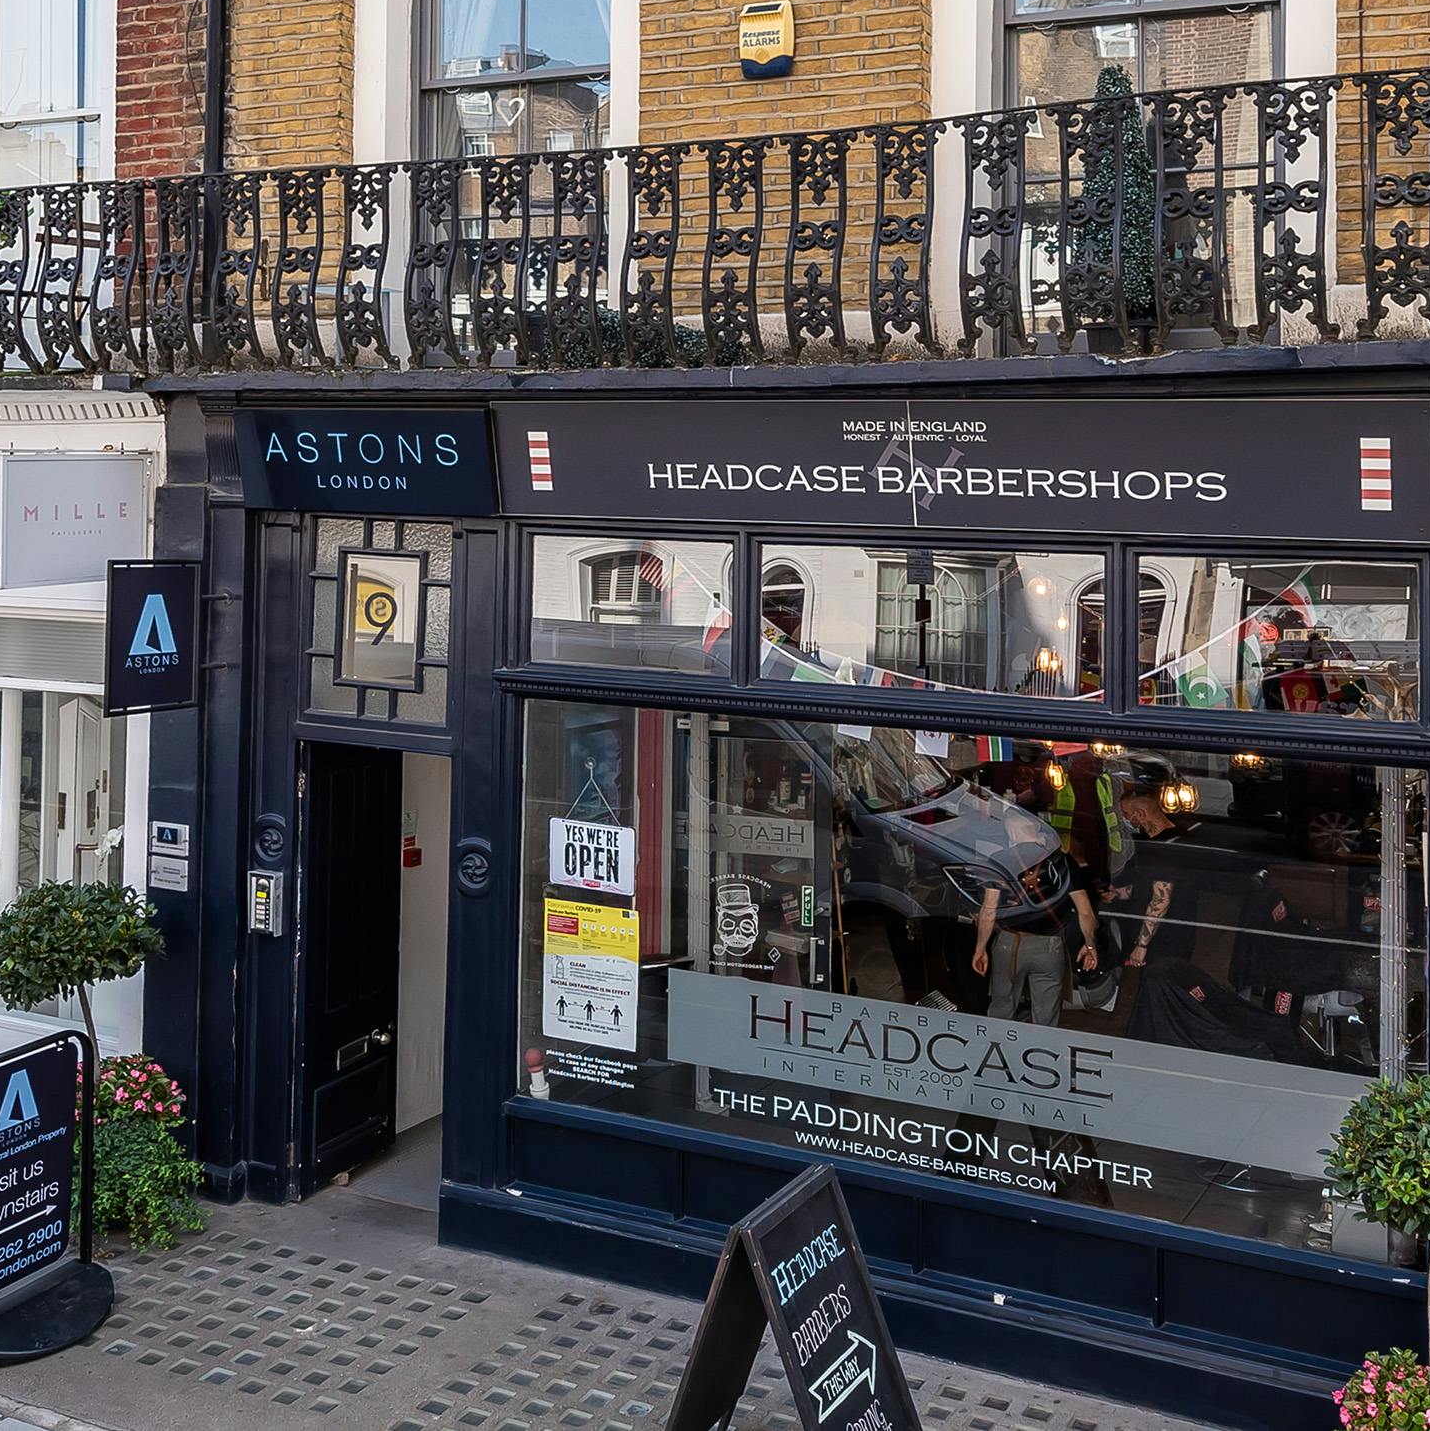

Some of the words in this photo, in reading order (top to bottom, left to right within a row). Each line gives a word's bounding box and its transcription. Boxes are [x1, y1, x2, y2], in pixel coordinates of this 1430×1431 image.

[742, 29, 780, 39] Response
[742, 36, 781, 48] ALARMS
[842, 421, 887, 432] MADE
[889, 421, 905, 433] IN
[911, 421, 987, 433] ENGLAND
[892, 433, 945, 442] AUTHENTIC
[955, 434, 988, 442] LOYAL
[265, 431, 460, 467] ASTONS
[317, 475, 408, 491] LONDON
[647, 463, 867, 494] HEADCASE
[876, 466, 1228, 502] BARBERSHOPS
[23, 502, 128, 522] MILLE
[364, 592, 398, 645] 9
[125, 653, 179, 669] ASTONS
[139, 667, 166, 675] LONDON
[565, 824, 585, 843] YES
[586, 827, 619, 848] WE'RE
[564, 843, 620, 883] OPEN
[803, 895, 812, 924] PULL
[570, 961, 586, 969] CLEAN
[832, 1001, 1019, 1041] BARBERS
[546, 1049, 565, 1058] please
[566, 1051, 583, 1060] check
[594, 1056, 621, 1067] facebook
[622, 1061, 638, 1071] page
[749, 994, 1115, 1103] HEADCASE
[548, 1068, 576, 1078] Headcase
[577, 1073, 600, 1083] Barbers
[601, 1076, 635, 1089] Paddington
[566, 1059, 580, 1067] case
[599, 1063, 624, 1074] changes
[572, 1066, 597, 1076] SEARCH
[597, 1070, 610, 1078] FOR
[883, 1064, 915, 1080] EST.
[919, 1069, 964, 1088] 2000
[761, 1056, 1095, 1129] INTERNATIONAL
[10, 1139, 37, 1156] London
[37, 1126, 68, 1144] Property
[714, 1087, 767, 1114] THE
[772, 1096, 999, 1160] PADDINGTON
[1007, 1143, 1153, 1189] CHAPTER
[23, 1160, 44, 1181] us
[796, 1131, 1057, 1193] WWW.HEADCASE-BARBERS.COM
[27, 1220, 63, 1250] 2900
[771, 1223, 845, 1306] HEADCASE
[793, 1283, 853, 1367] BARBERS
[823, 1372, 844, 1401] THIS
[840, 1355, 862, 1384] WAY
